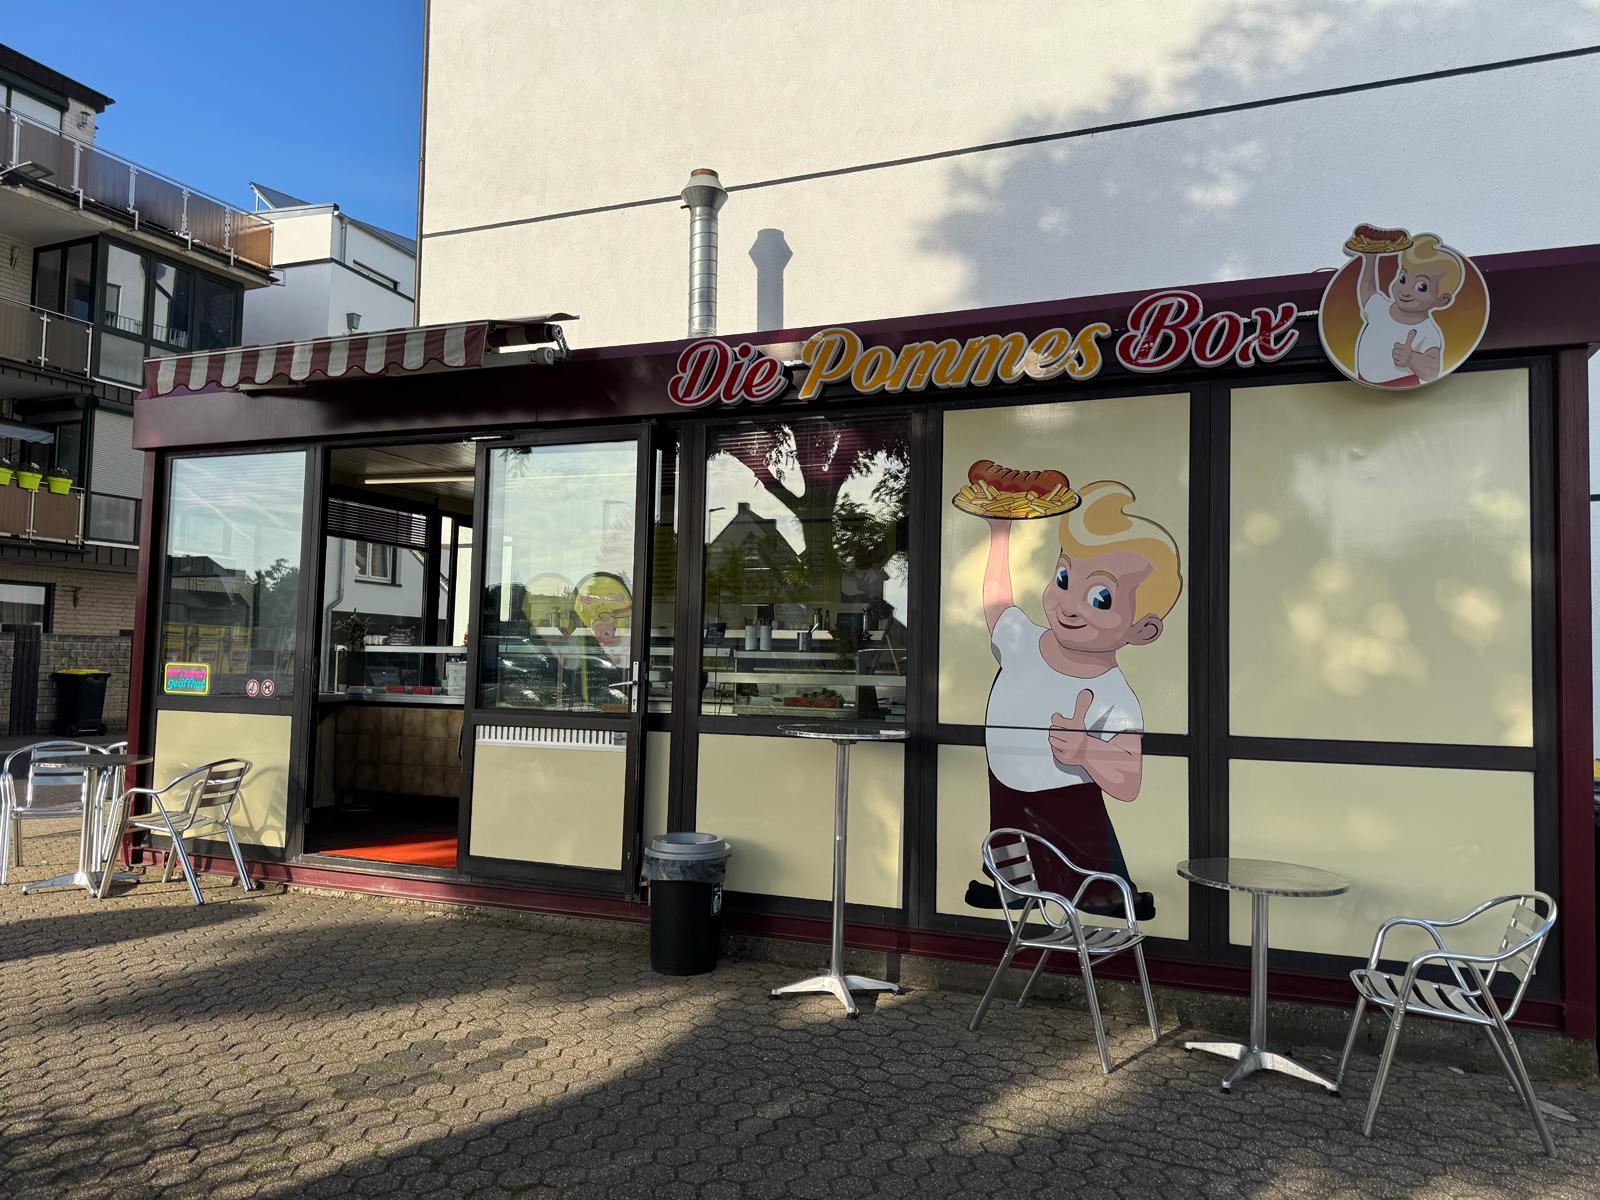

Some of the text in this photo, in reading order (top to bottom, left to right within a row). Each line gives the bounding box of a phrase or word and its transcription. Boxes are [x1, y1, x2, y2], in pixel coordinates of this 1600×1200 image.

[668, 290, 1299, 407] Die Pommes Box
[167, 678, 206, 690] geöffnet
